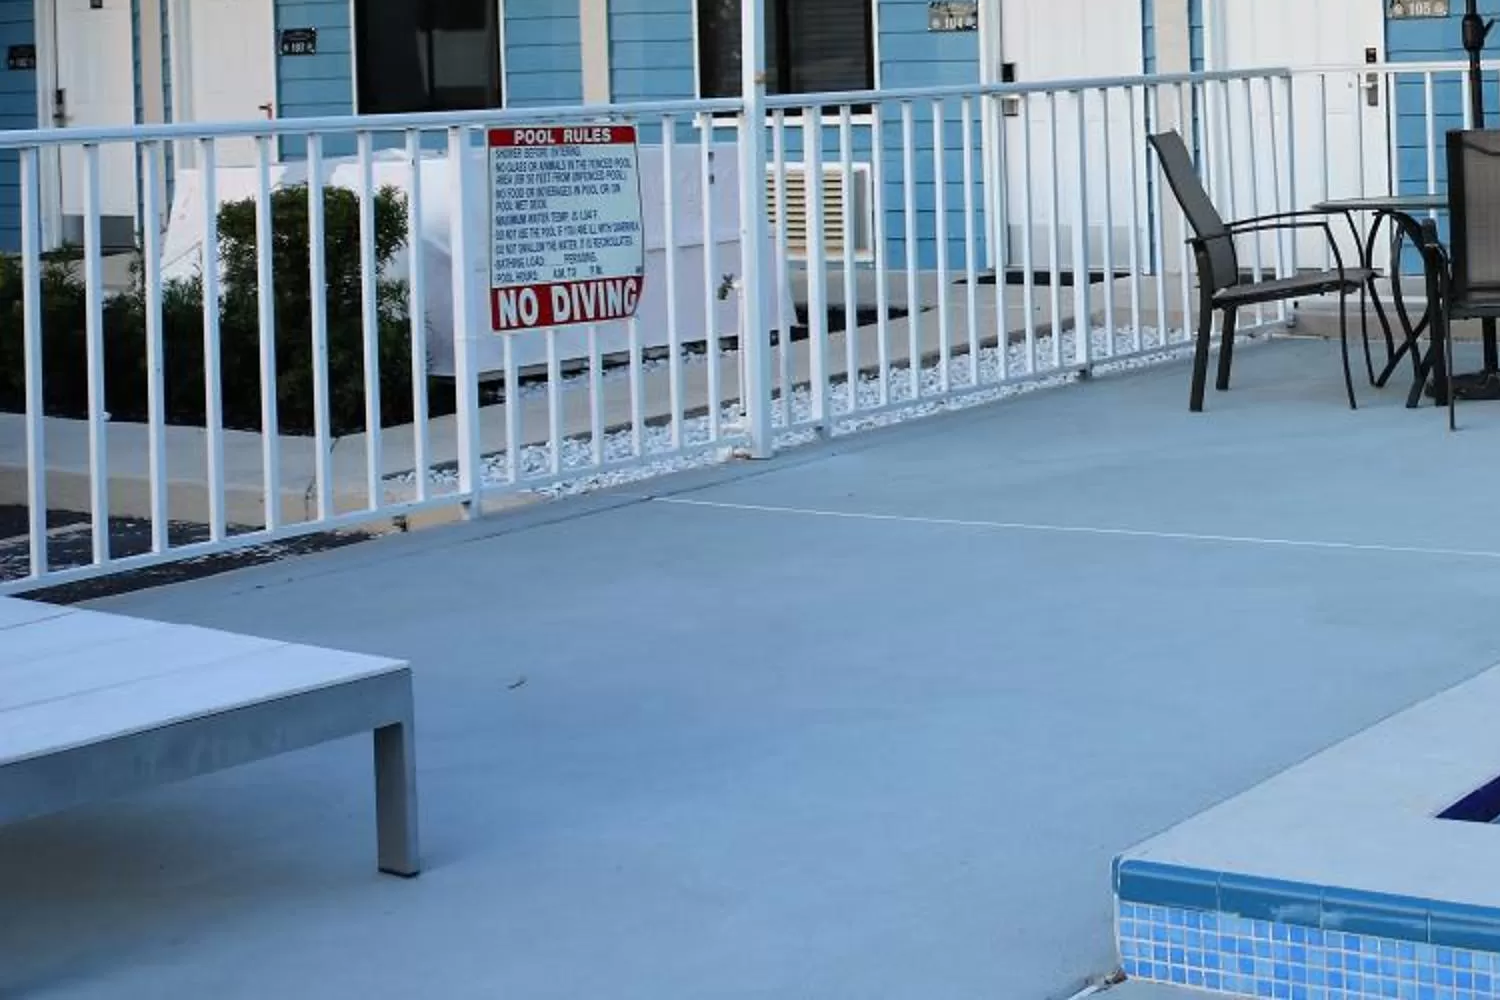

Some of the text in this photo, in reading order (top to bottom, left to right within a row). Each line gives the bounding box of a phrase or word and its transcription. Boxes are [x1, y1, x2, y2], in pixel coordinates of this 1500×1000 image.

[1410, 2, 1431, 15] 105
[514, 127, 611, 144] POOL RULES
[498, 278, 638, 328] NO DIVING
